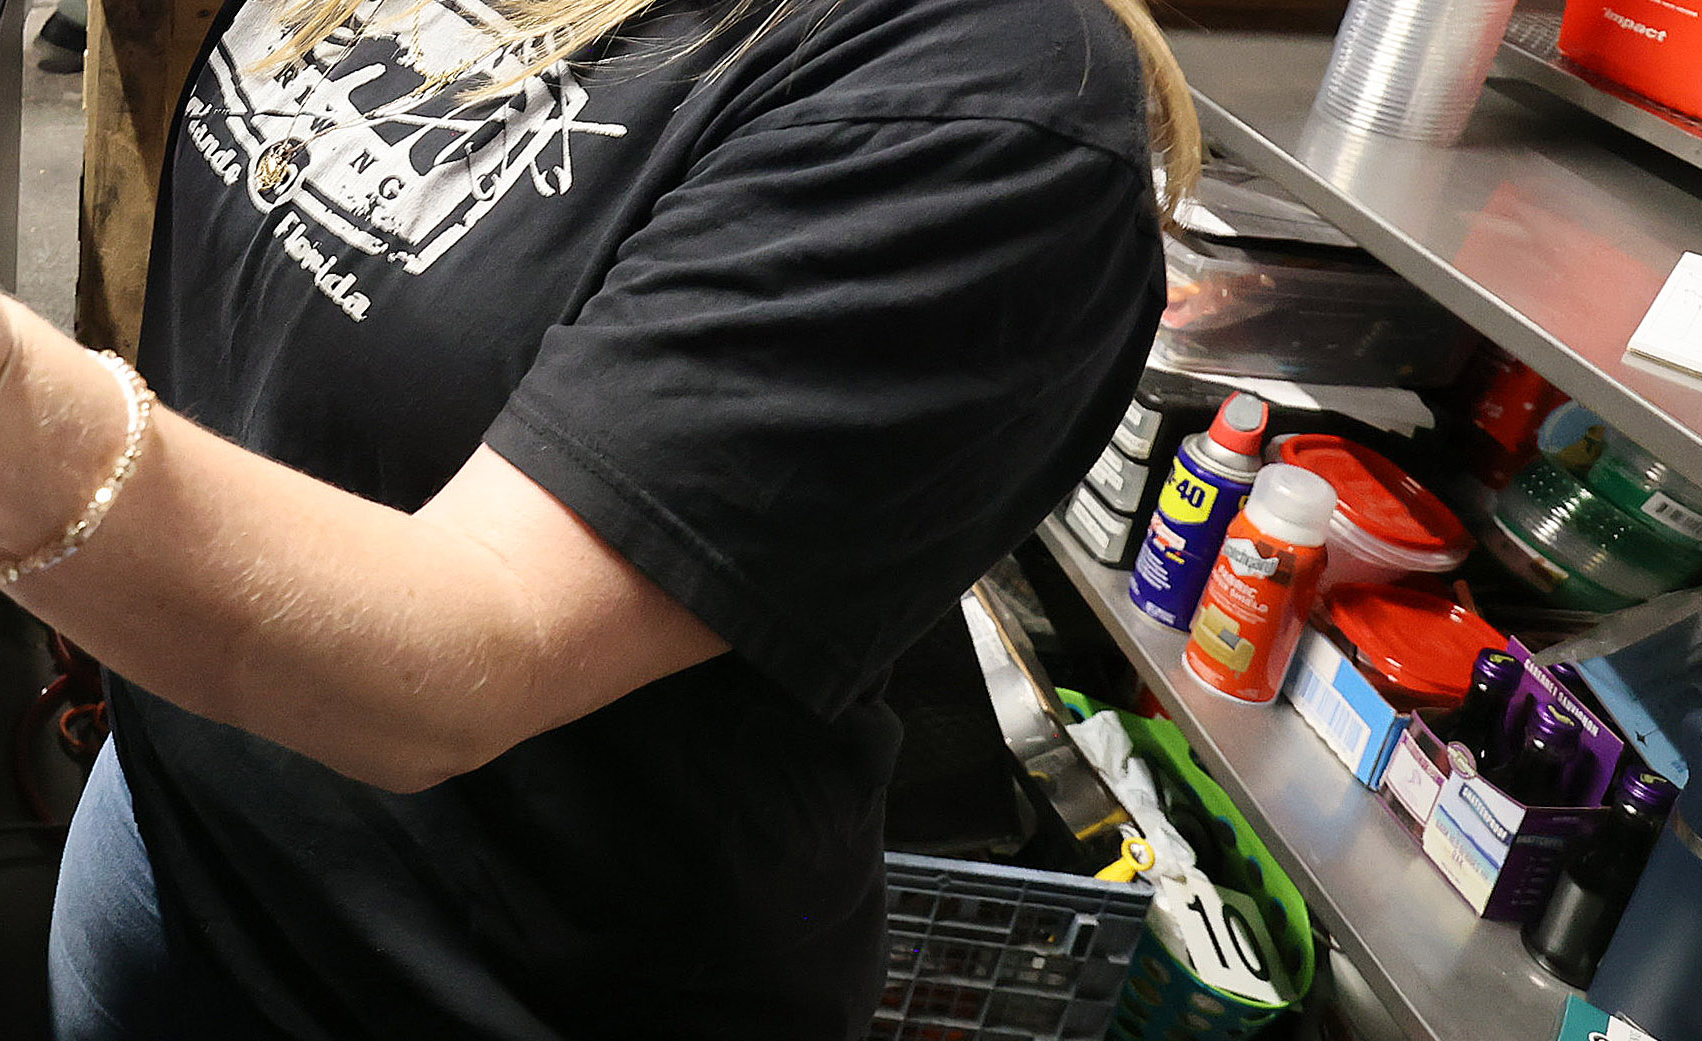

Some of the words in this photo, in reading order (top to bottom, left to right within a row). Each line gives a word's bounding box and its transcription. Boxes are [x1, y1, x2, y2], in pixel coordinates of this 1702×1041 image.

[272, 210, 372, 323] Florida
[1556, 692, 1600, 737] SAUVIGNON
[1186, 894, 1270, 982] 10
